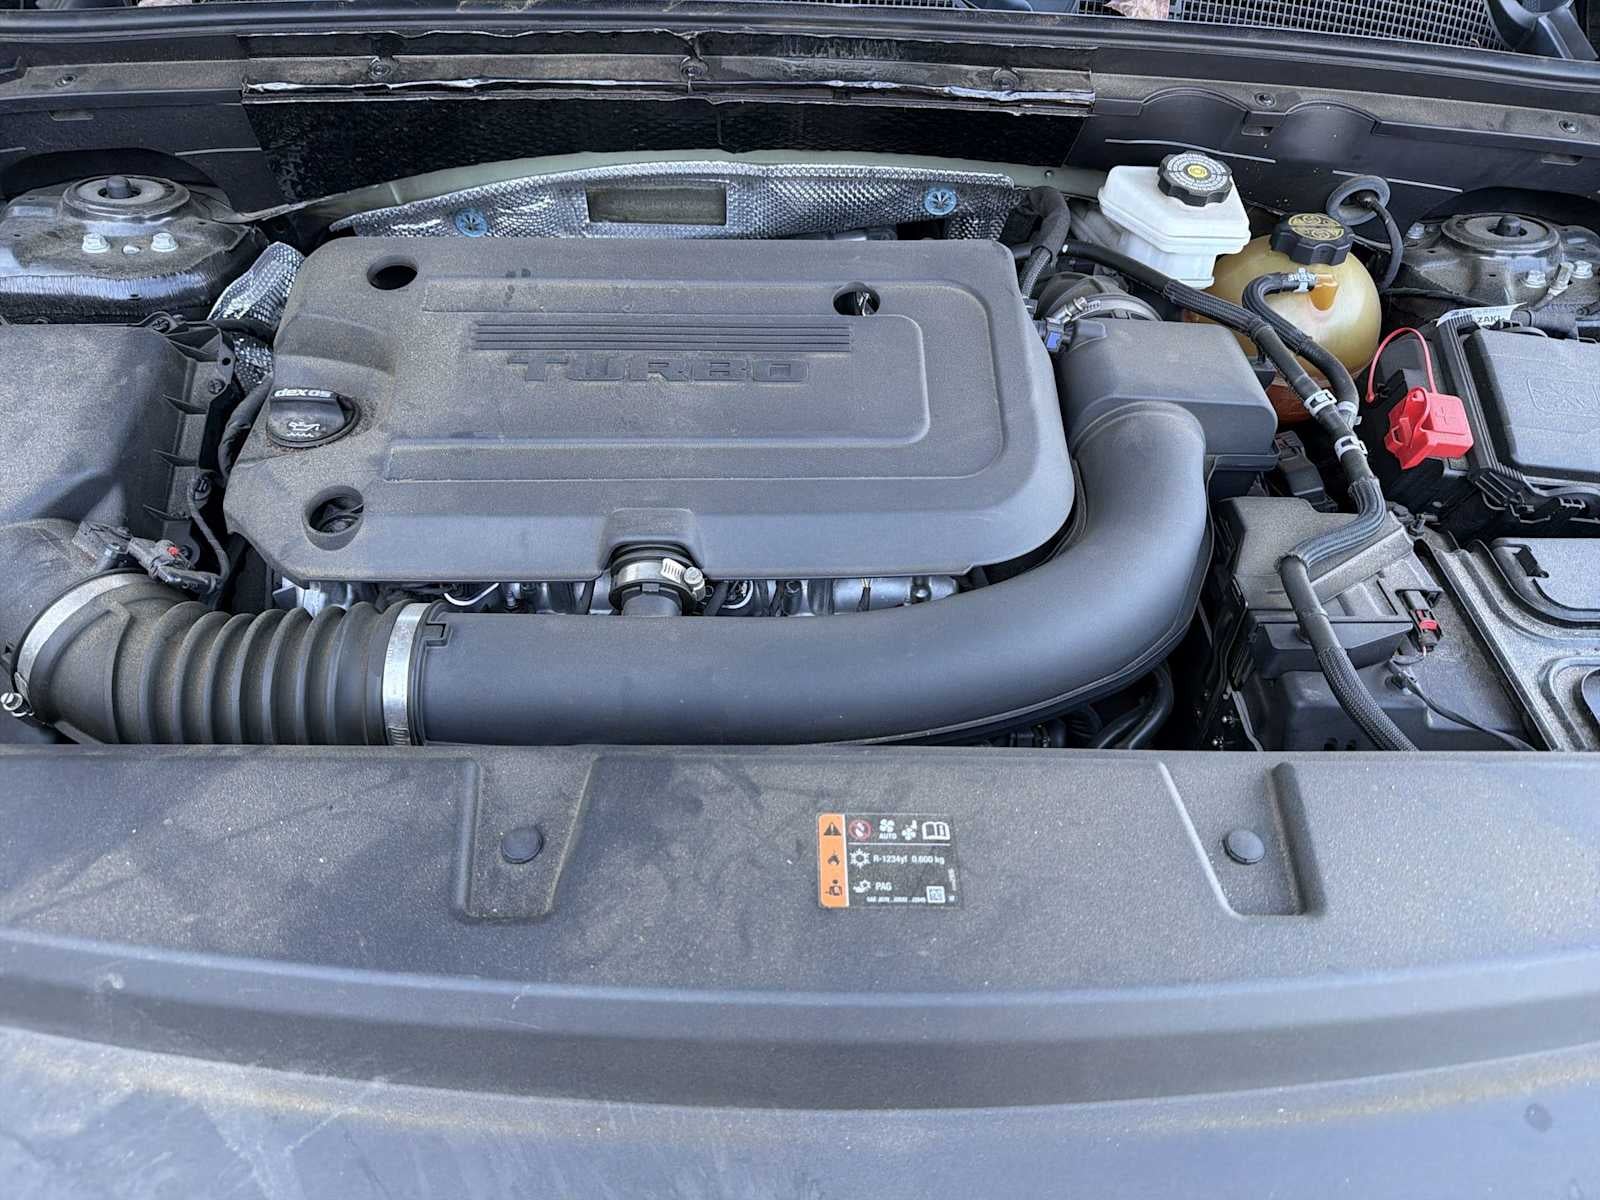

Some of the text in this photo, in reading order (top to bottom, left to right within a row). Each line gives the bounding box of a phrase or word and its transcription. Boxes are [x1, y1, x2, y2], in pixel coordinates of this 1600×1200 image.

[507, 351, 808, 382] TURBO
[274, 388, 333, 398] dexos
[879, 832, 897, 840] AUTO
[873, 854, 908, 864] R-1234yf
[934, 856, 945, 865] kg
[875, 881, 892, 891] PAG
